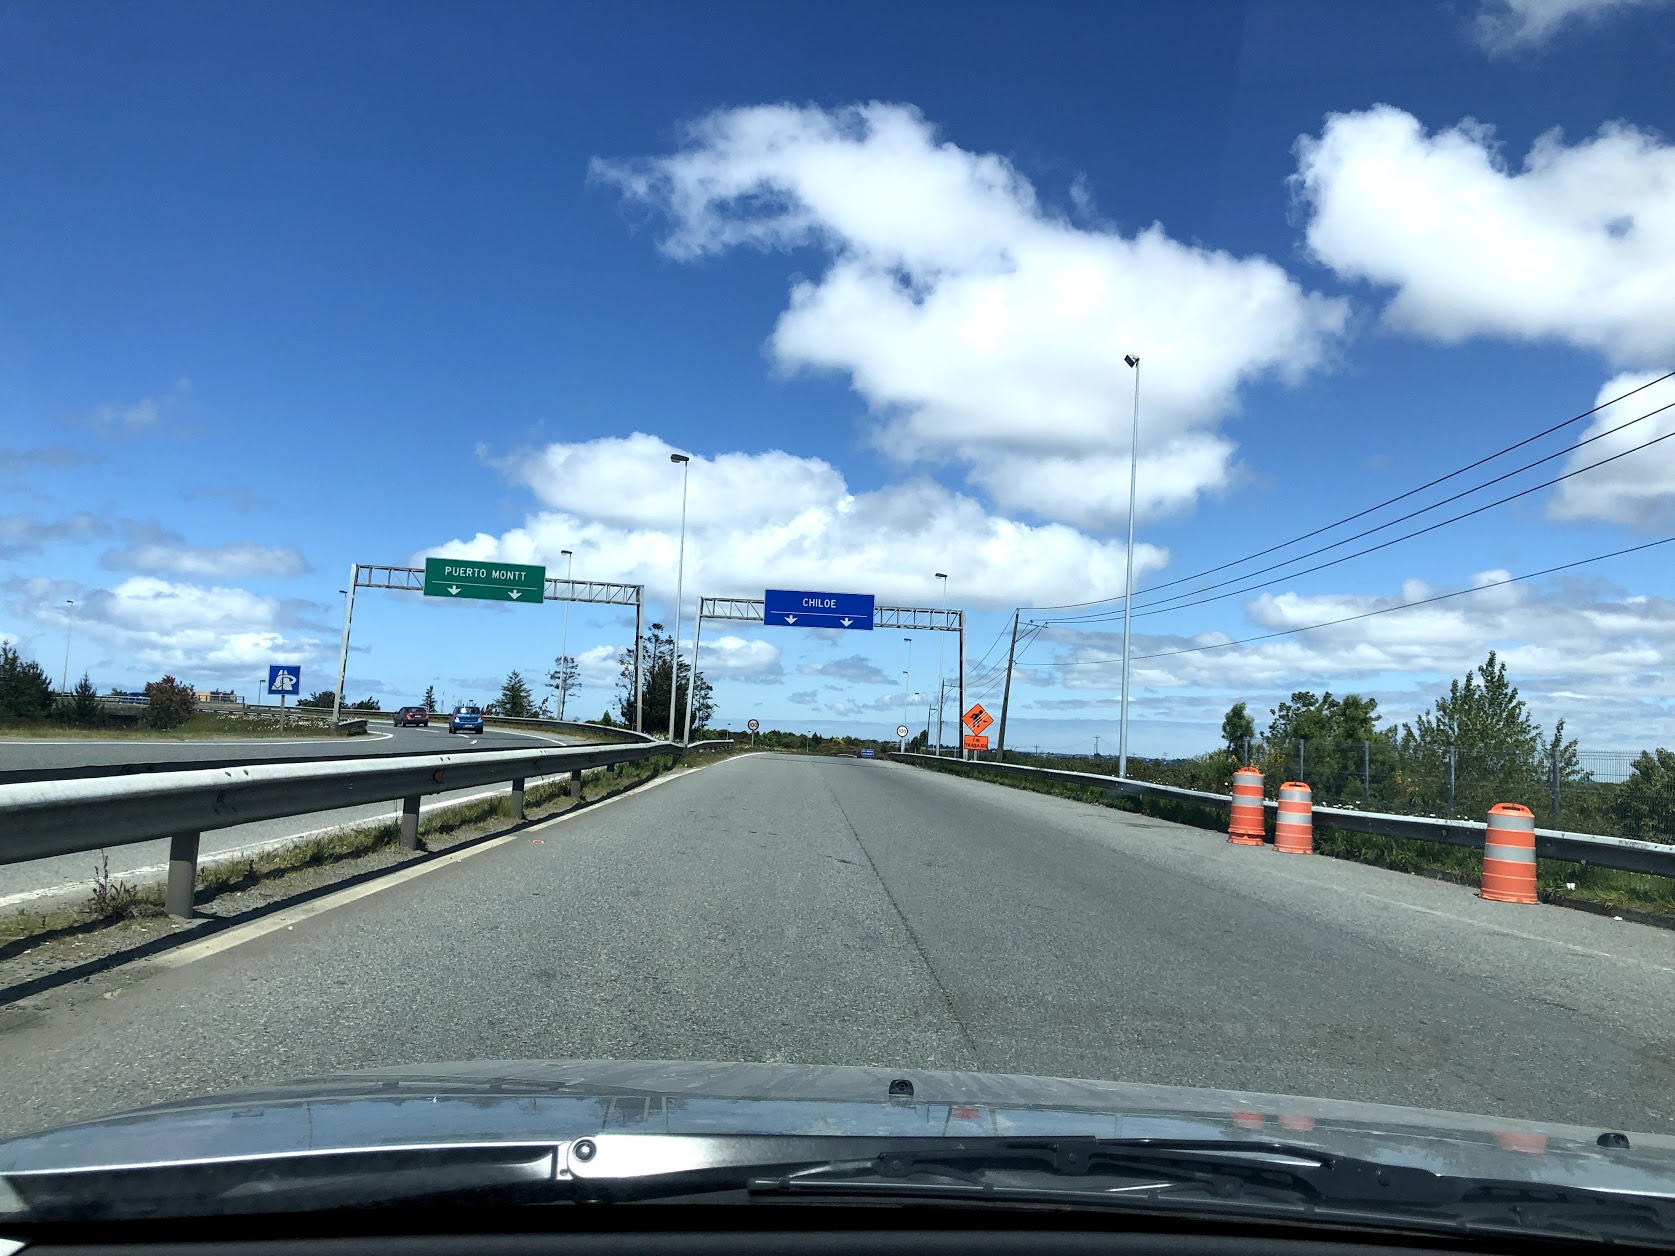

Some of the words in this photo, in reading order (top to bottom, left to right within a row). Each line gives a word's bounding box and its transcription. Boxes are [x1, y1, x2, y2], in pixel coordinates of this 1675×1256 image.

[445, 566, 487, 578] PUERTO
[492, 569, 527, 580] MONTT
[802, 598, 837, 608] CHILOE
